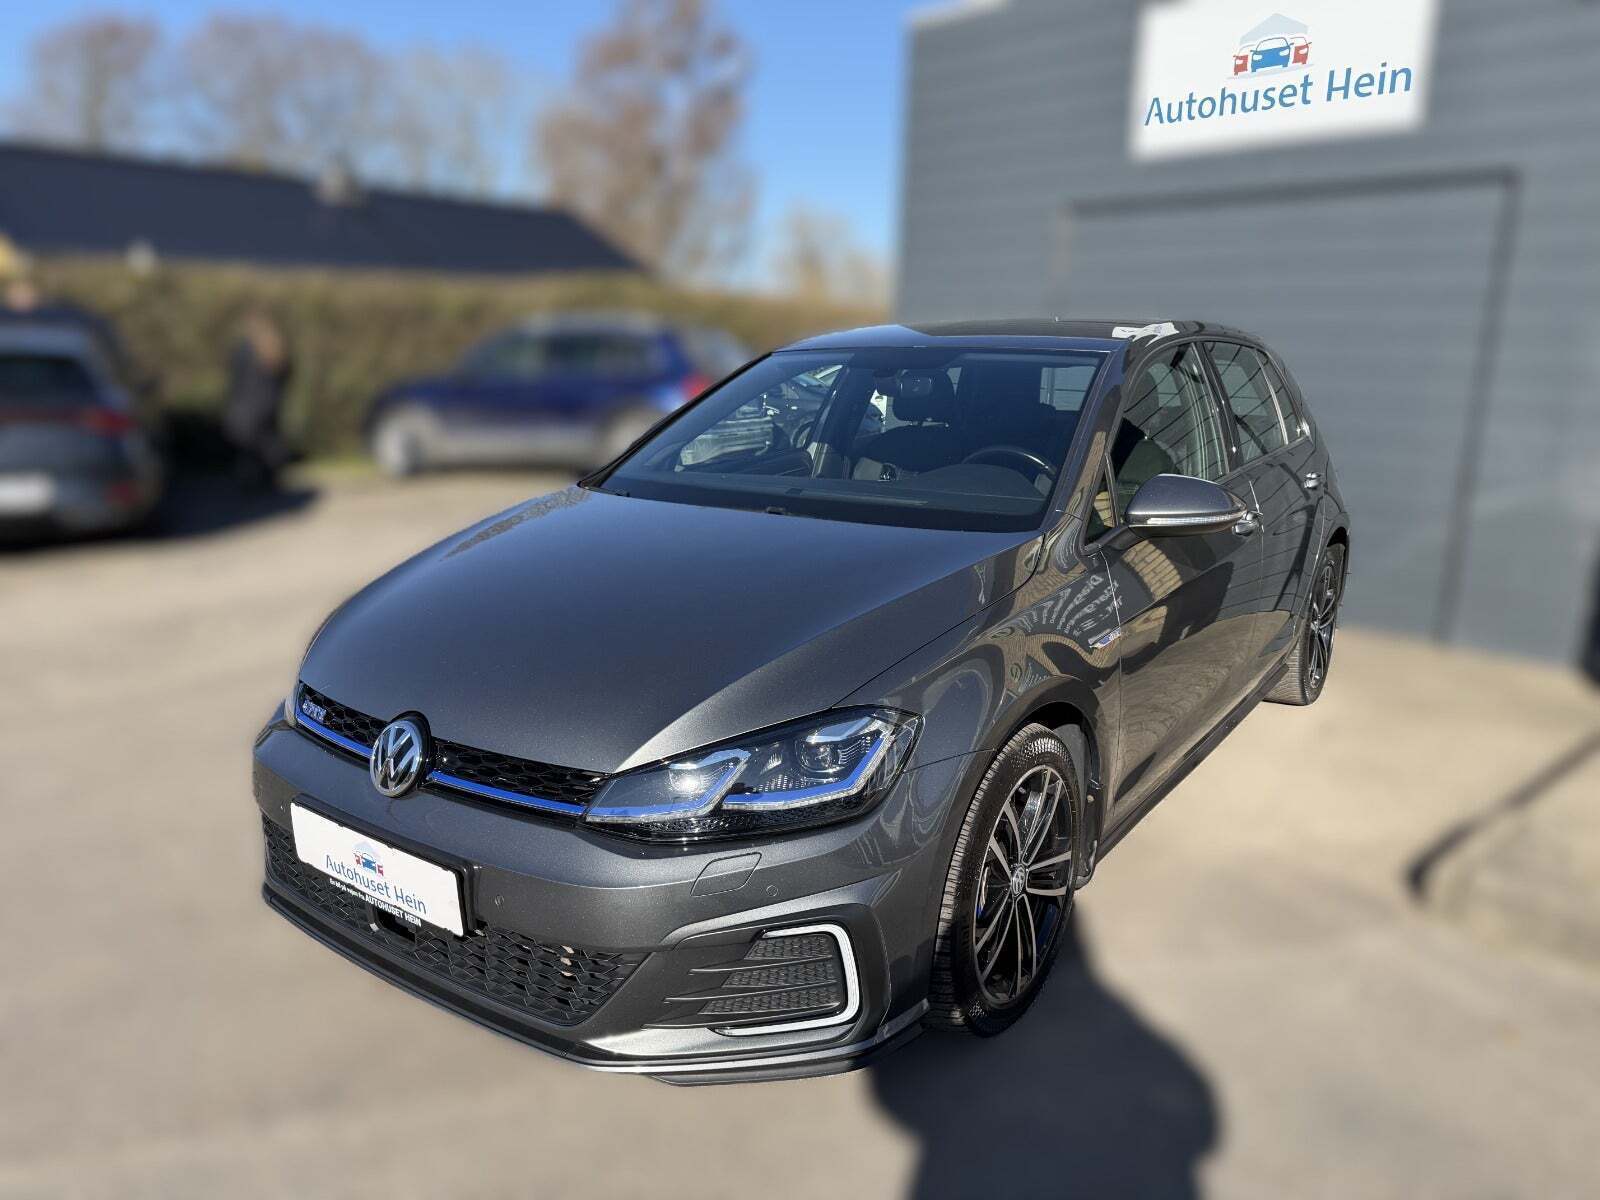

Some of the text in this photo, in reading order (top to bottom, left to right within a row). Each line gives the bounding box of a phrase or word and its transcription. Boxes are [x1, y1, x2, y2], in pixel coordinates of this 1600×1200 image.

[1144, 61, 1413, 126] Autohuset Hein
[326, 854, 390, 899] Autohuset
[393, 885, 427, 915] Hein
[365, 894, 422, 927] AUTOHUSET HEIN
